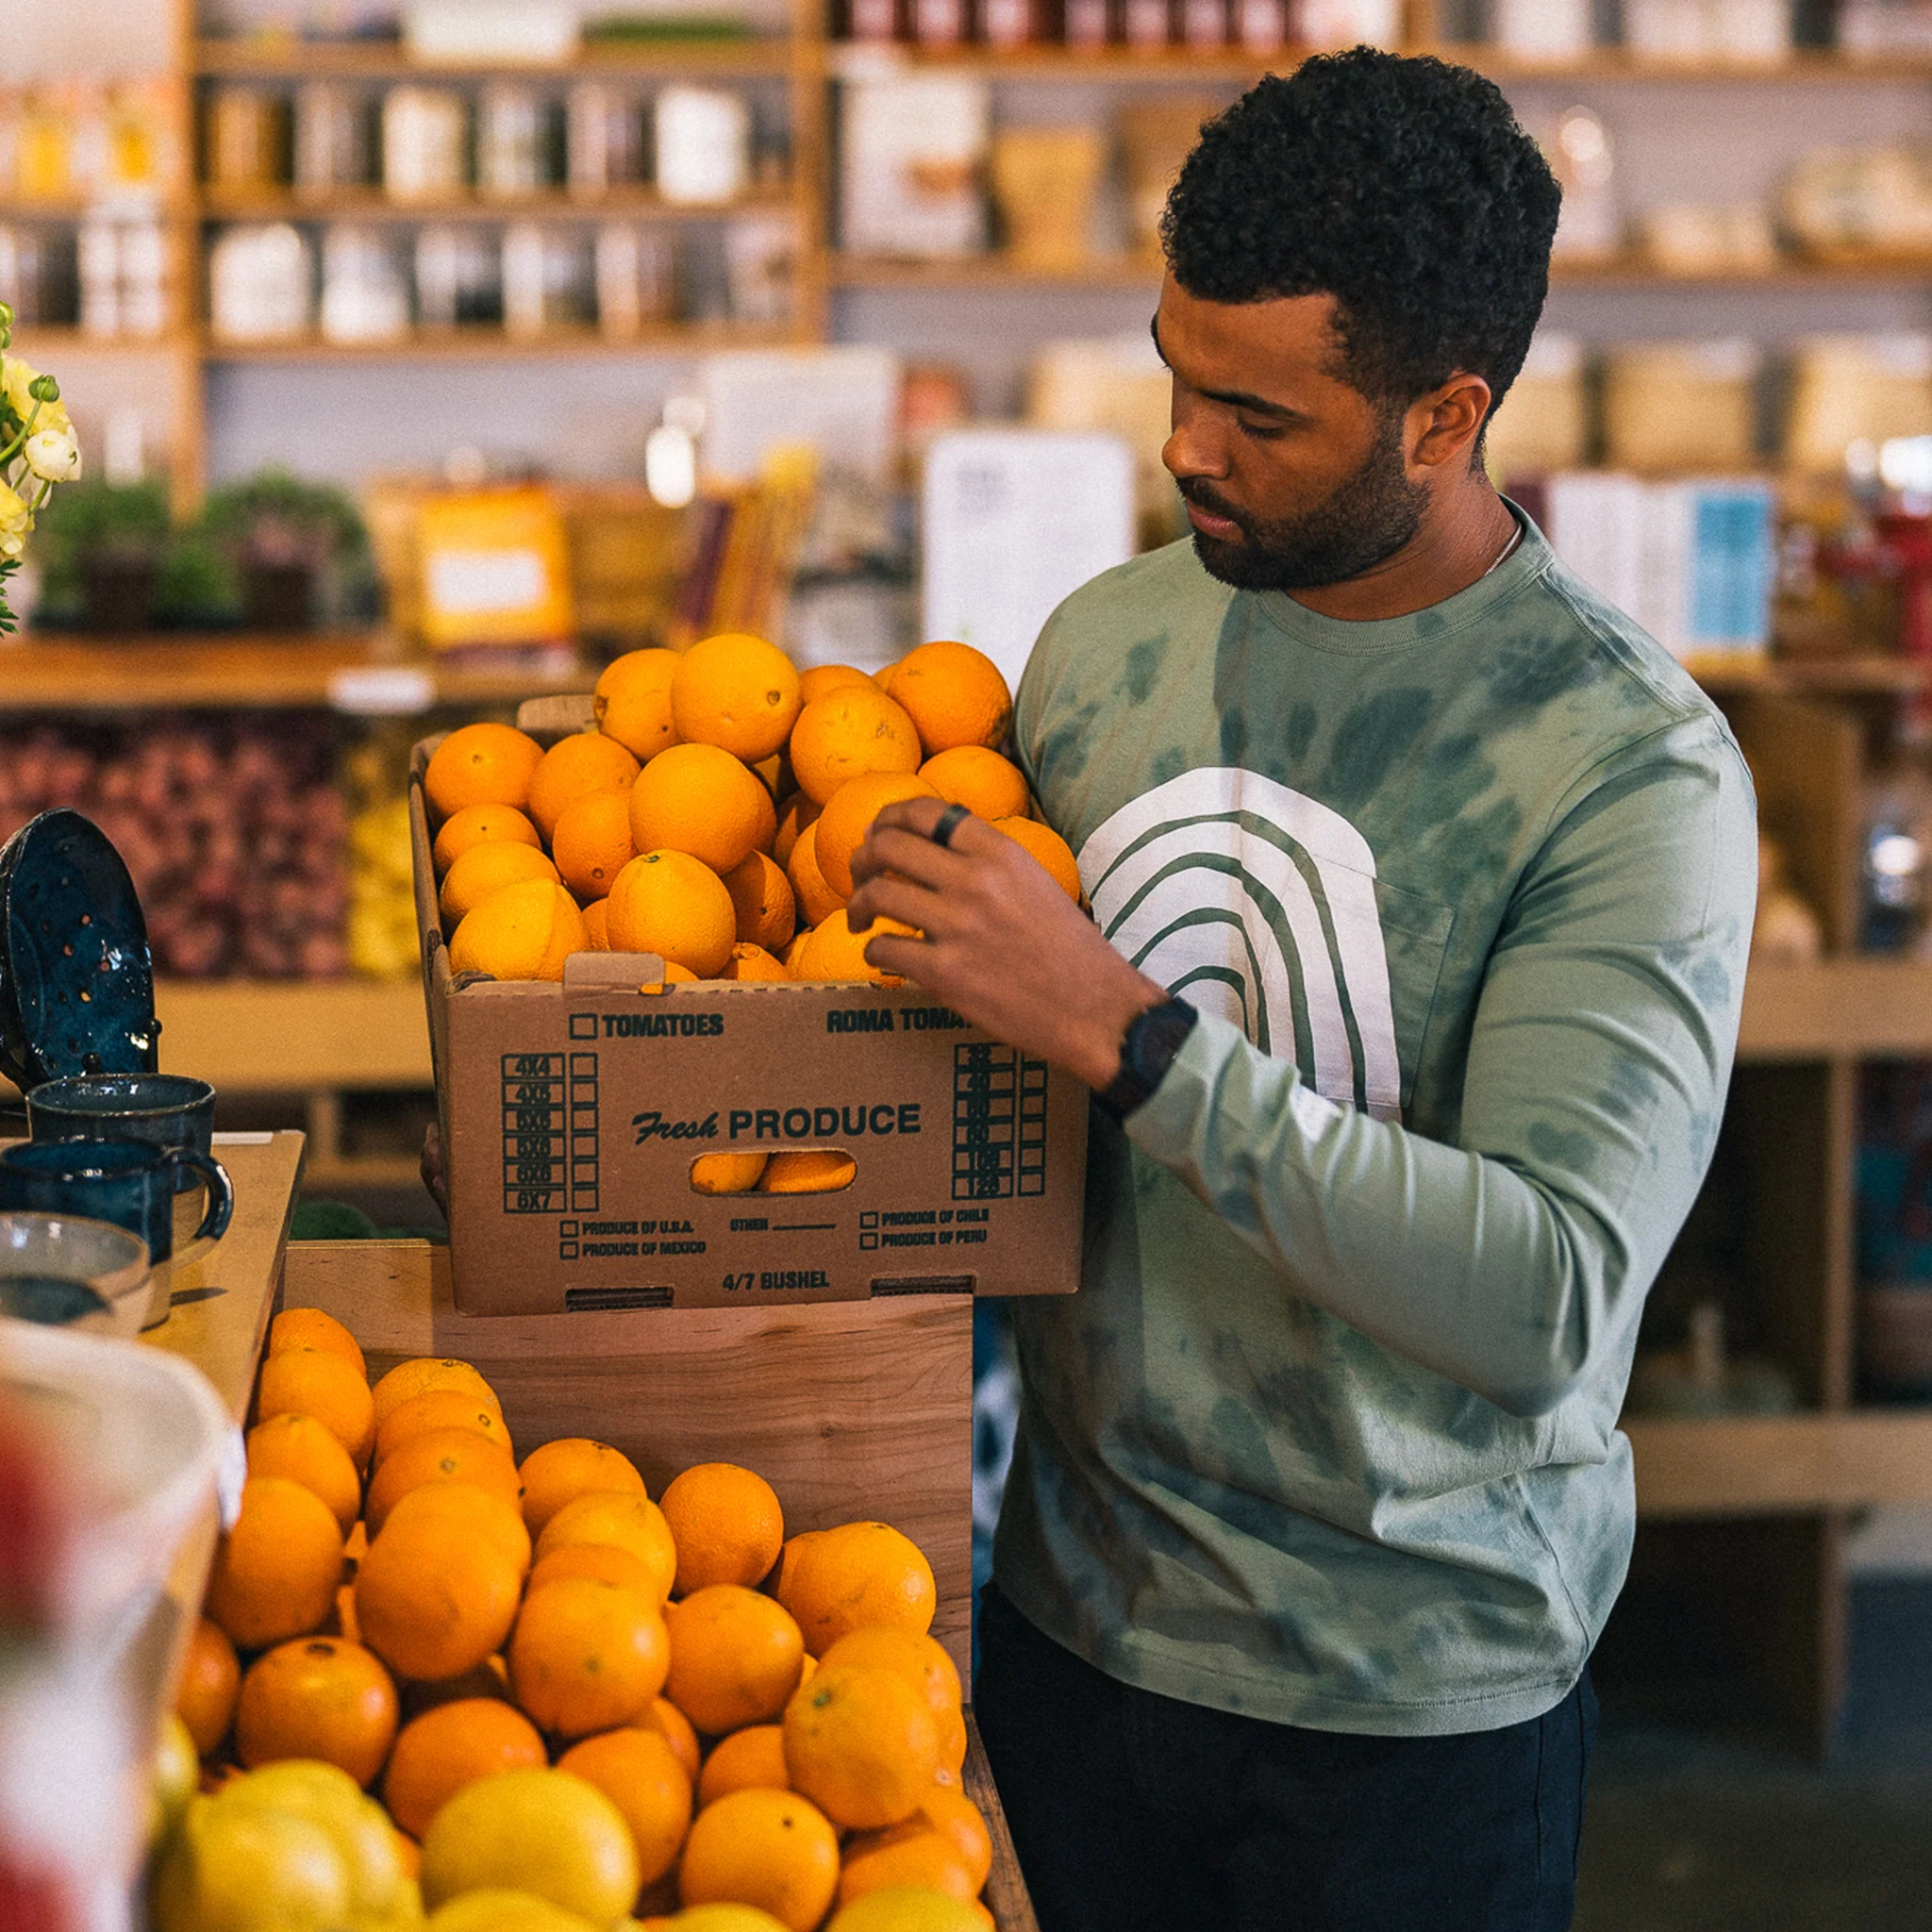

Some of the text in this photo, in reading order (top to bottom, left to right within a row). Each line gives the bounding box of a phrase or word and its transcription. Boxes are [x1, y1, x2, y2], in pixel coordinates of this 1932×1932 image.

[602, 1013, 724, 1038] TOMATOES
[826, 1007, 973, 1033] ROMA TOMA
[515, 1053, 550, 1078] 4X4
[631, 1103, 922, 1145] Fresh PRODUCE
[518, 1189, 551, 1212] 6X7
[730, 1218, 769, 1232] OTHER
[882, 1210, 936, 1226] PRODUCE
[939, 1209, 954, 1224] OF
[582, 1221, 639, 1235] PRODUCE
[641, 1221, 658, 1234] OF
[882, 1229, 988, 1247] PRODUCE OF PERU
[582, 1241, 707, 1257] PRODUCE OF MEXICO
[722, 1271, 830, 1291] 4/7 BUSHEL
